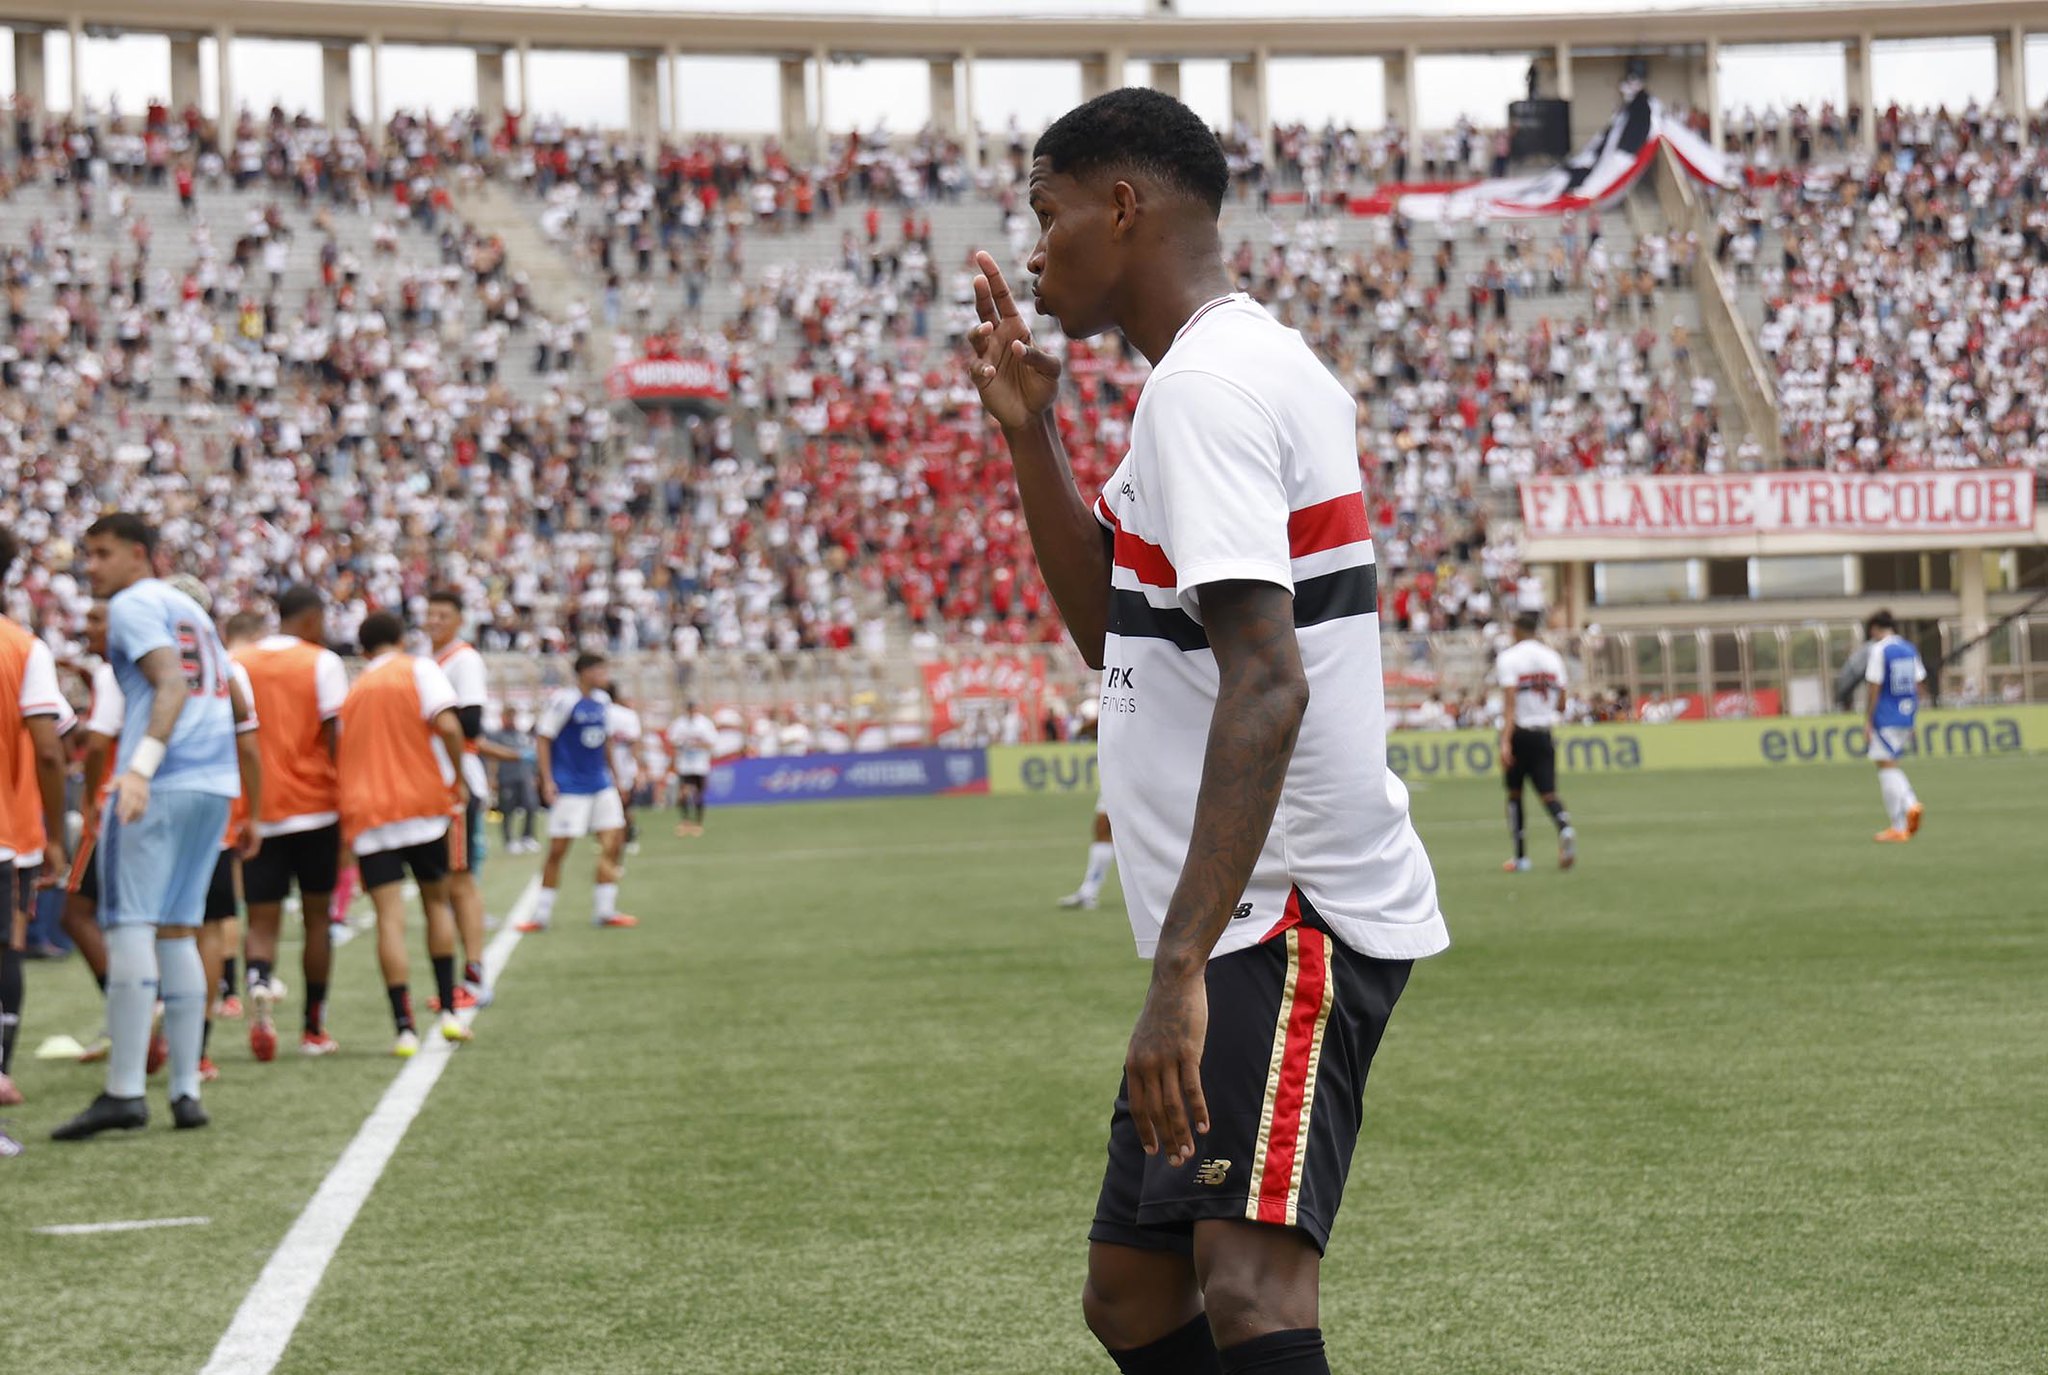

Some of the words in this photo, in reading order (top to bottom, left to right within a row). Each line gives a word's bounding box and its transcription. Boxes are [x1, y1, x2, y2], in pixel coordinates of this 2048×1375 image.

[1528, 480, 1755, 529] FALANGE
[1769, 478, 2018, 525] TRICOLOR
[1386, 734, 1642, 777] euroma
[1760, 717, 2021, 762] euroarma
[1021, 753, 1098, 791] eur
